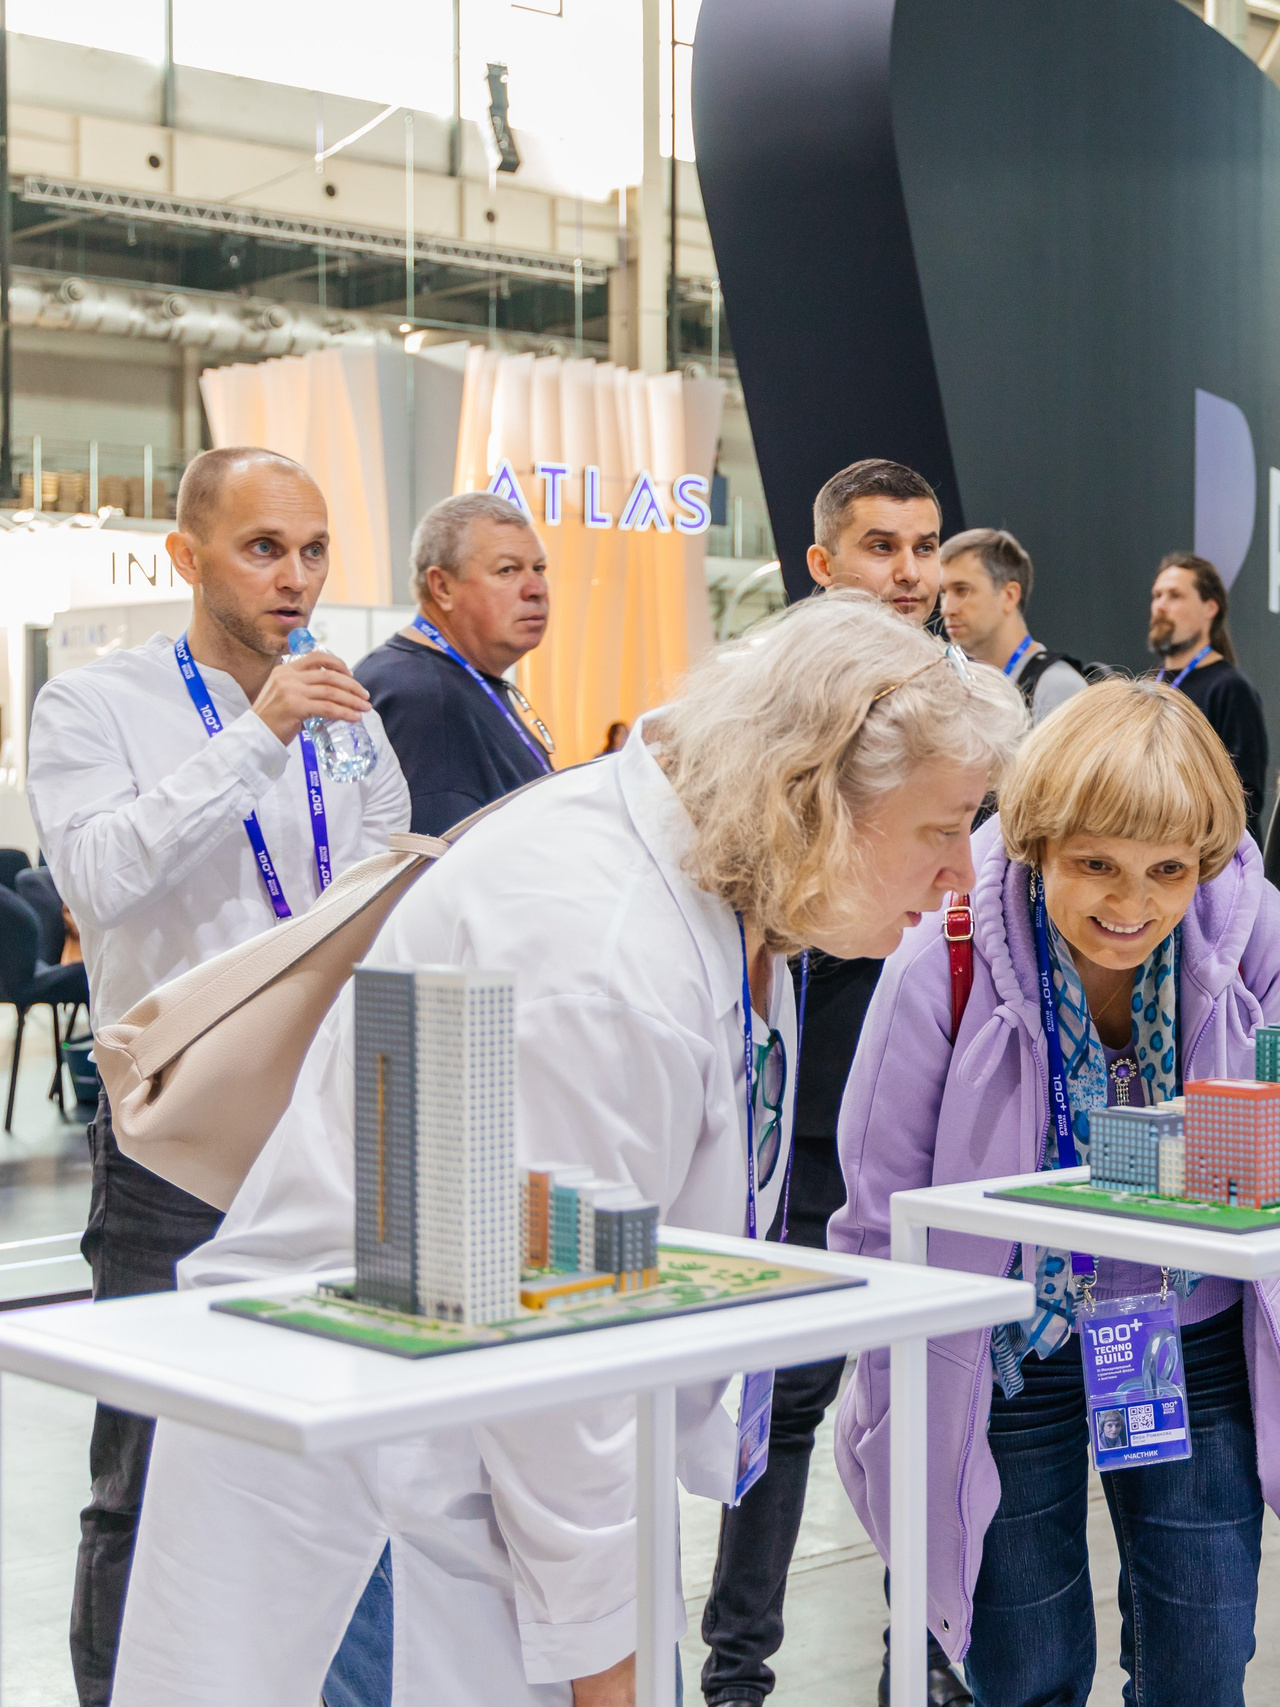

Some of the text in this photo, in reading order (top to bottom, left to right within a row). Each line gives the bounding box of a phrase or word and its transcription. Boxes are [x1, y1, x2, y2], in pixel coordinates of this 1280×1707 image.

[486, 457, 712, 535] ATLAS
[112, 552, 174, 588] IN
[175, 639, 190, 662] 100+
[200, 704, 221, 730] 100+
[309, 788, 323, 816] 100+
[257, 850, 275, 878] 100+
[319, 864, 331, 891] 00+
[1041, 970, 1053, 1007] 100+
[1053, 1074, 1067, 1111] 100+
[1088, 1318, 1142, 1345] 100+
[1094, 1342, 1132, 1355] TECHNO
[1095, 1350, 1134, 1366] BUILD
[1161, 1400, 1178, 1409] 100+
[1123, 1449, 1159, 1461] УЧАСТНИК
